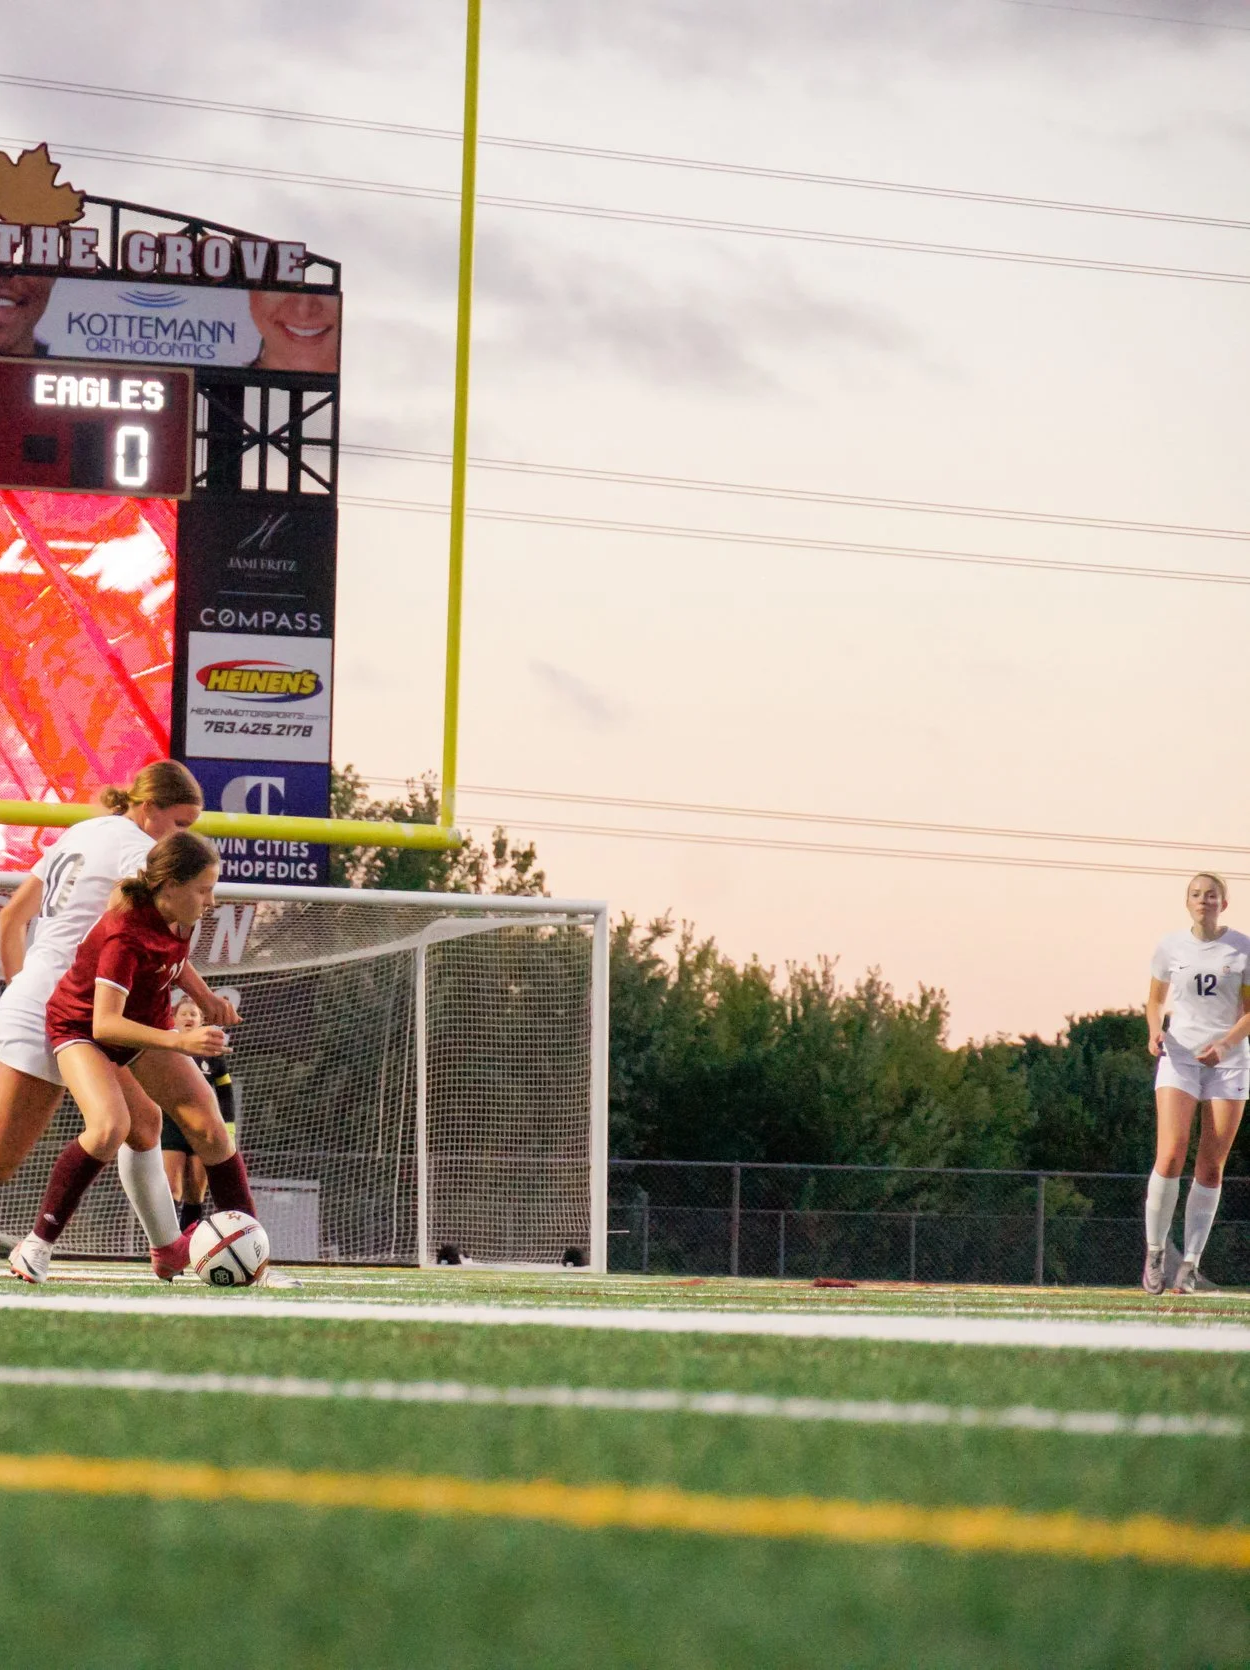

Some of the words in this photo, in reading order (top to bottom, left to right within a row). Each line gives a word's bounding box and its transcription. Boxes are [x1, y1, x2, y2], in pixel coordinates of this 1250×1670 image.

[127, 231, 307, 283] GROVE
[66, 311, 237, 345] KOTTEMANN
[85, 338, 217, 360] ORTHODONTICS
[34, 373, 165, 413] EAGLES
[115, 424, 149, 487] 0
[200, 607, 322, 632] COMPASS
[205, 669, 319, 697] HEINEN'S
[203, 719, 314, 738] 763.425.2178
[212, 838, 248, 855] WIN
[253, 839, 310, 858] CITIES
[218, 859, 318, 880] THOPEDICS
[1194, 973, 1217, 996] 12
